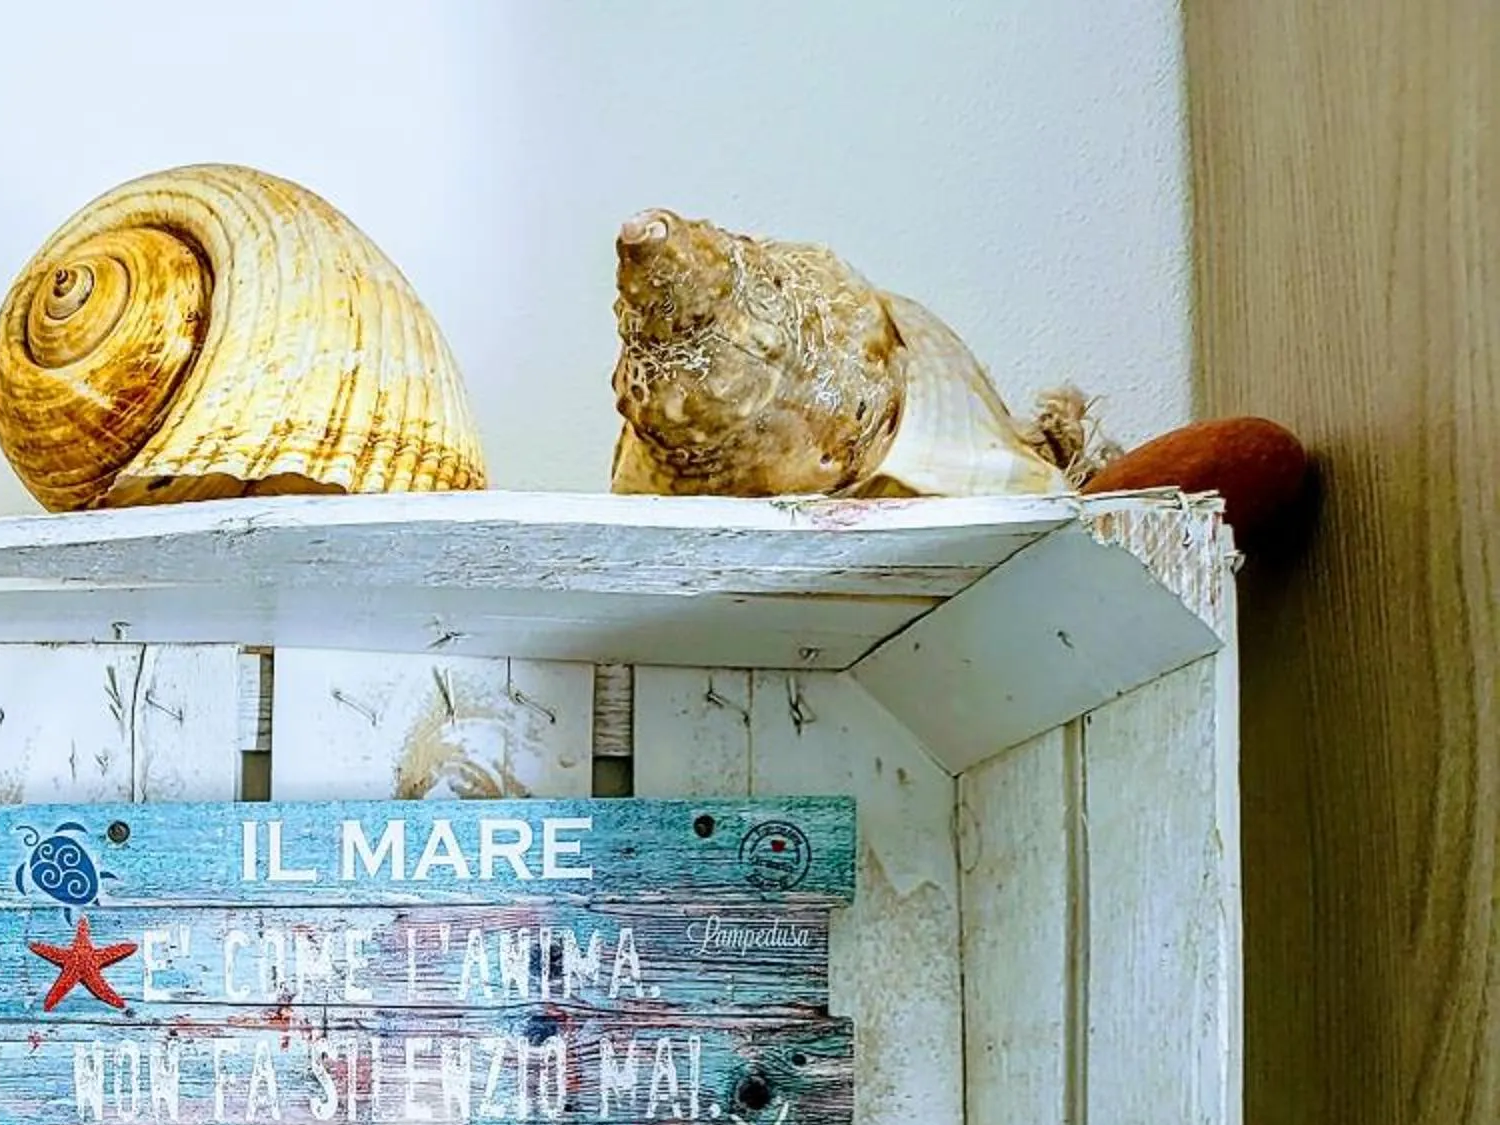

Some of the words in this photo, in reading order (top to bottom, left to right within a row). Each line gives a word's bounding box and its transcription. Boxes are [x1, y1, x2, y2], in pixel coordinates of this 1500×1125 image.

[241, 819, 317, 882] IL
[340, 816, 594, 882] MARE
[223, 929, 374, 1001] COME
[686, 914, 810, 957] Lampedusa
[73, 1038, 180, 1122] NON
[213, 1037, 283, 1122] FA
[308, 1036, 567, 1121] SILENZIO
